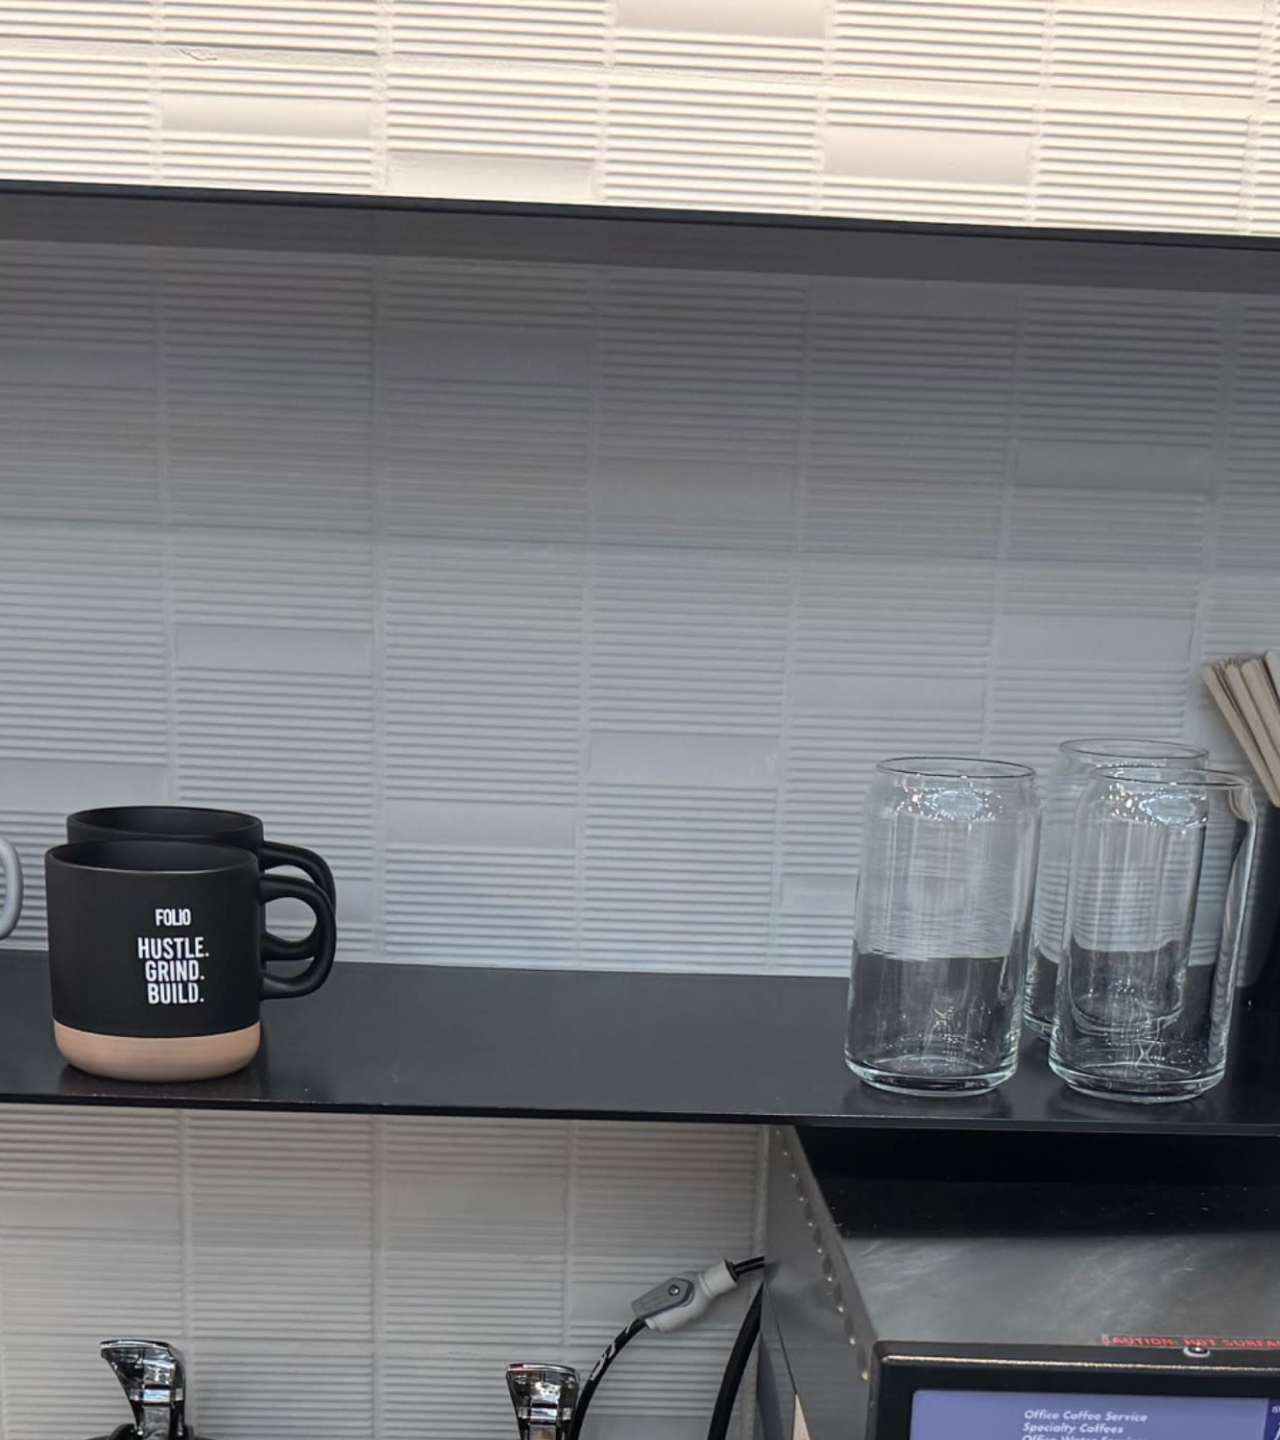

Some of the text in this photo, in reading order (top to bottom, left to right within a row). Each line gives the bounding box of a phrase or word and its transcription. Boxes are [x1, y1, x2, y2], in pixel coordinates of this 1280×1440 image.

[155, 908, 191, 926] FOLIO
[137, 936, 209, 959] HUSTLE.
[145, 960, 205, 981] GRIND.
[147, 982, 205, 1004] BUILD.
[1024, 1410, 1148, 1422] Office Coffee Service
[1023, 1422, 1123, 1434] Specialty Coffees
